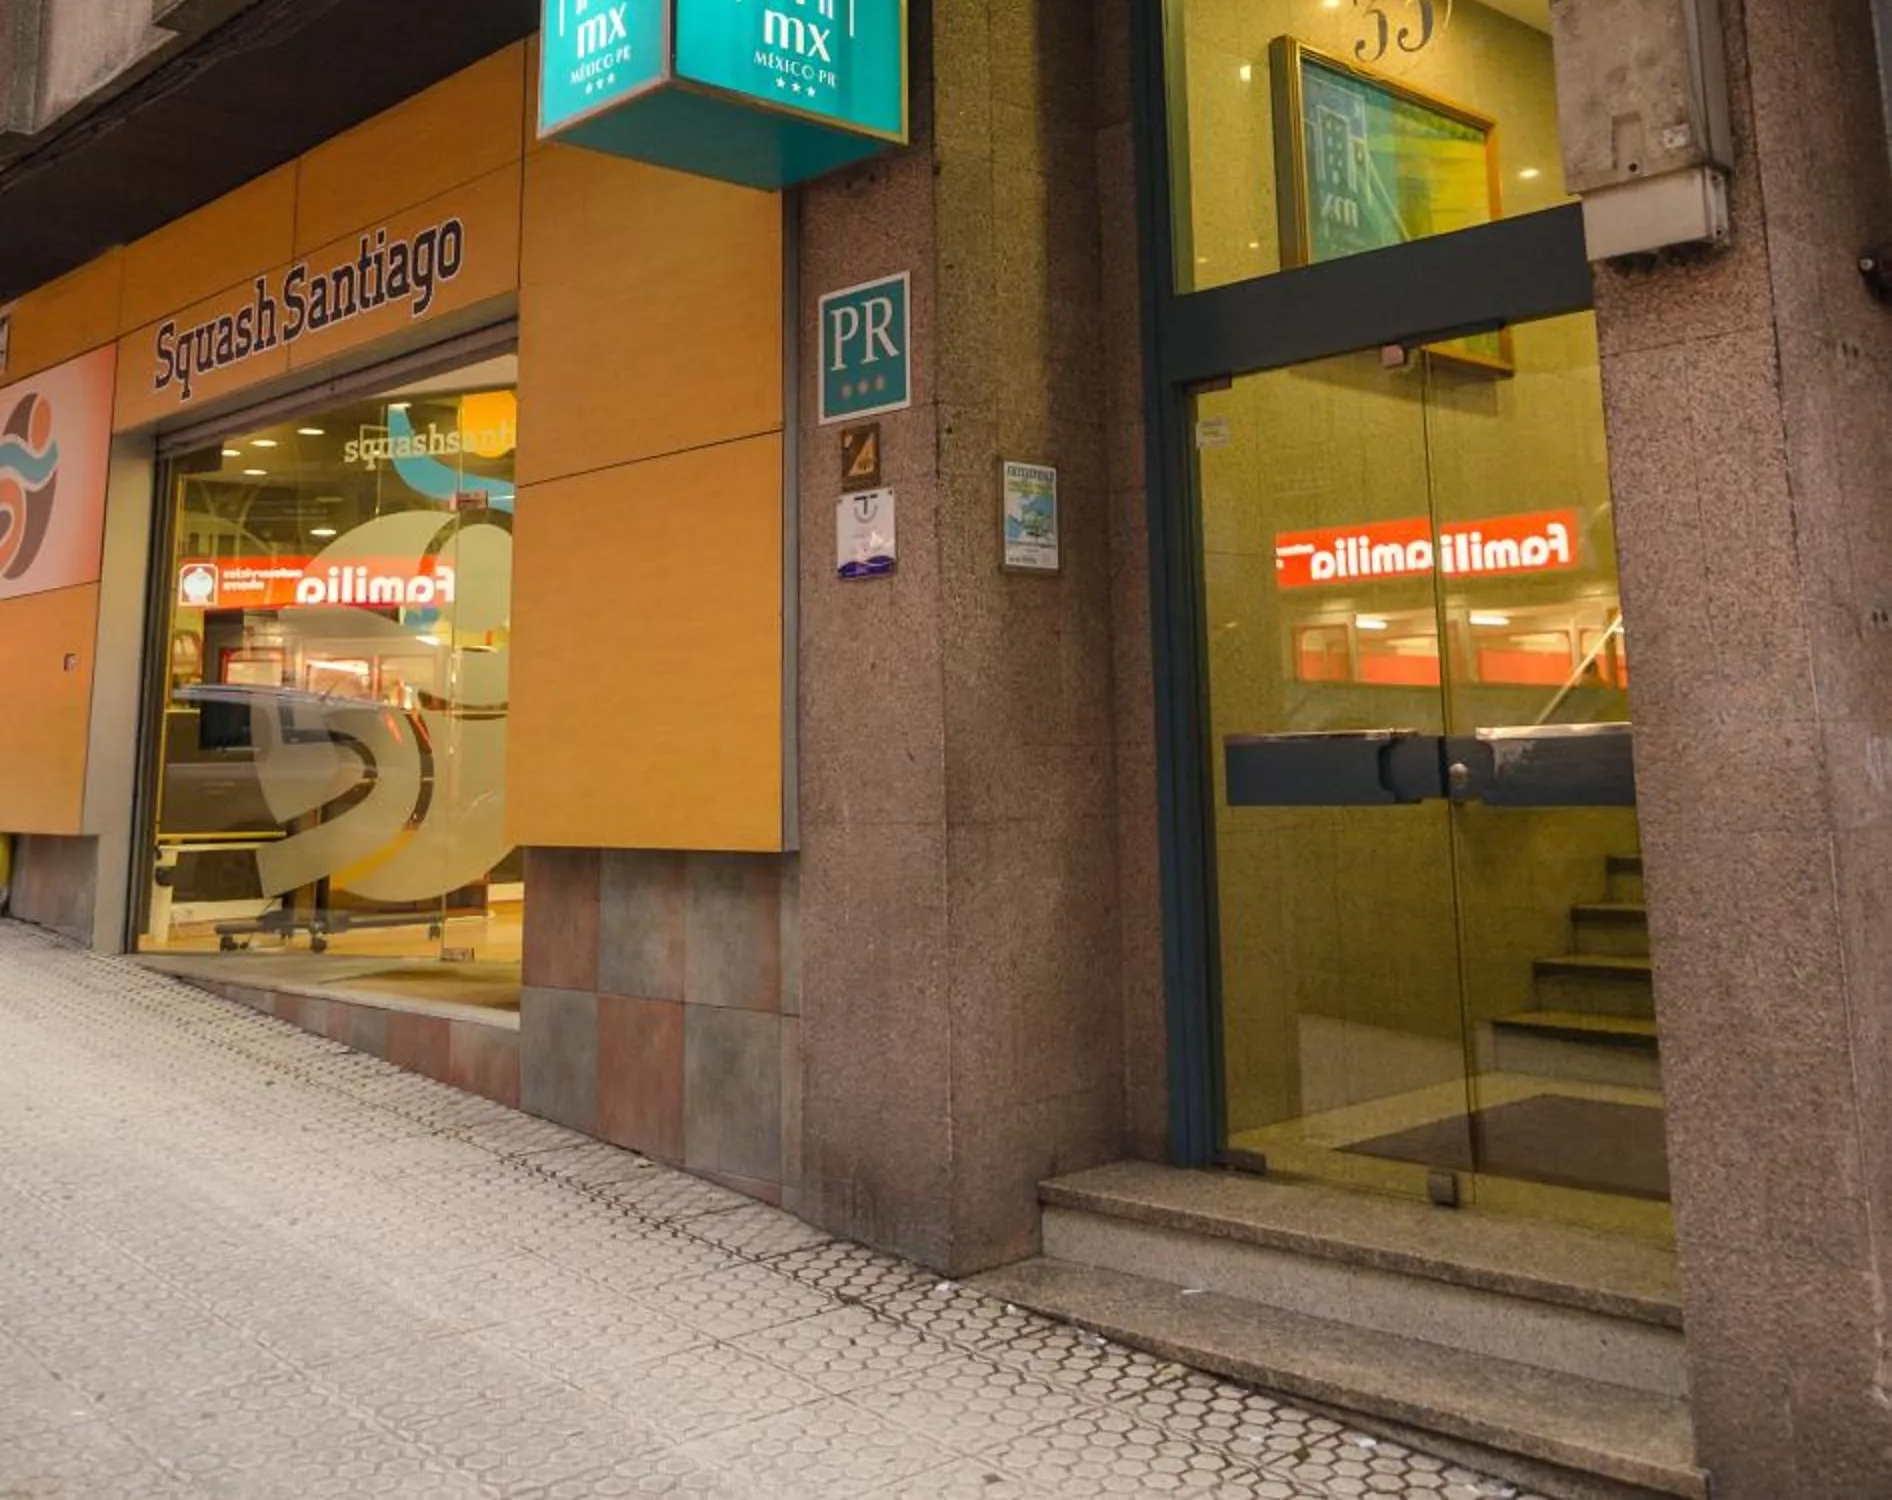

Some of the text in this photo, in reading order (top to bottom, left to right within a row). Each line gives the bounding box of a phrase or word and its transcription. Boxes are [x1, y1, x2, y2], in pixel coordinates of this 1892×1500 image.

[764, 8, 832, 63] mx
[154, 217, 464, 401] Squash Santiago
[829, 297, 900, 372] PR
